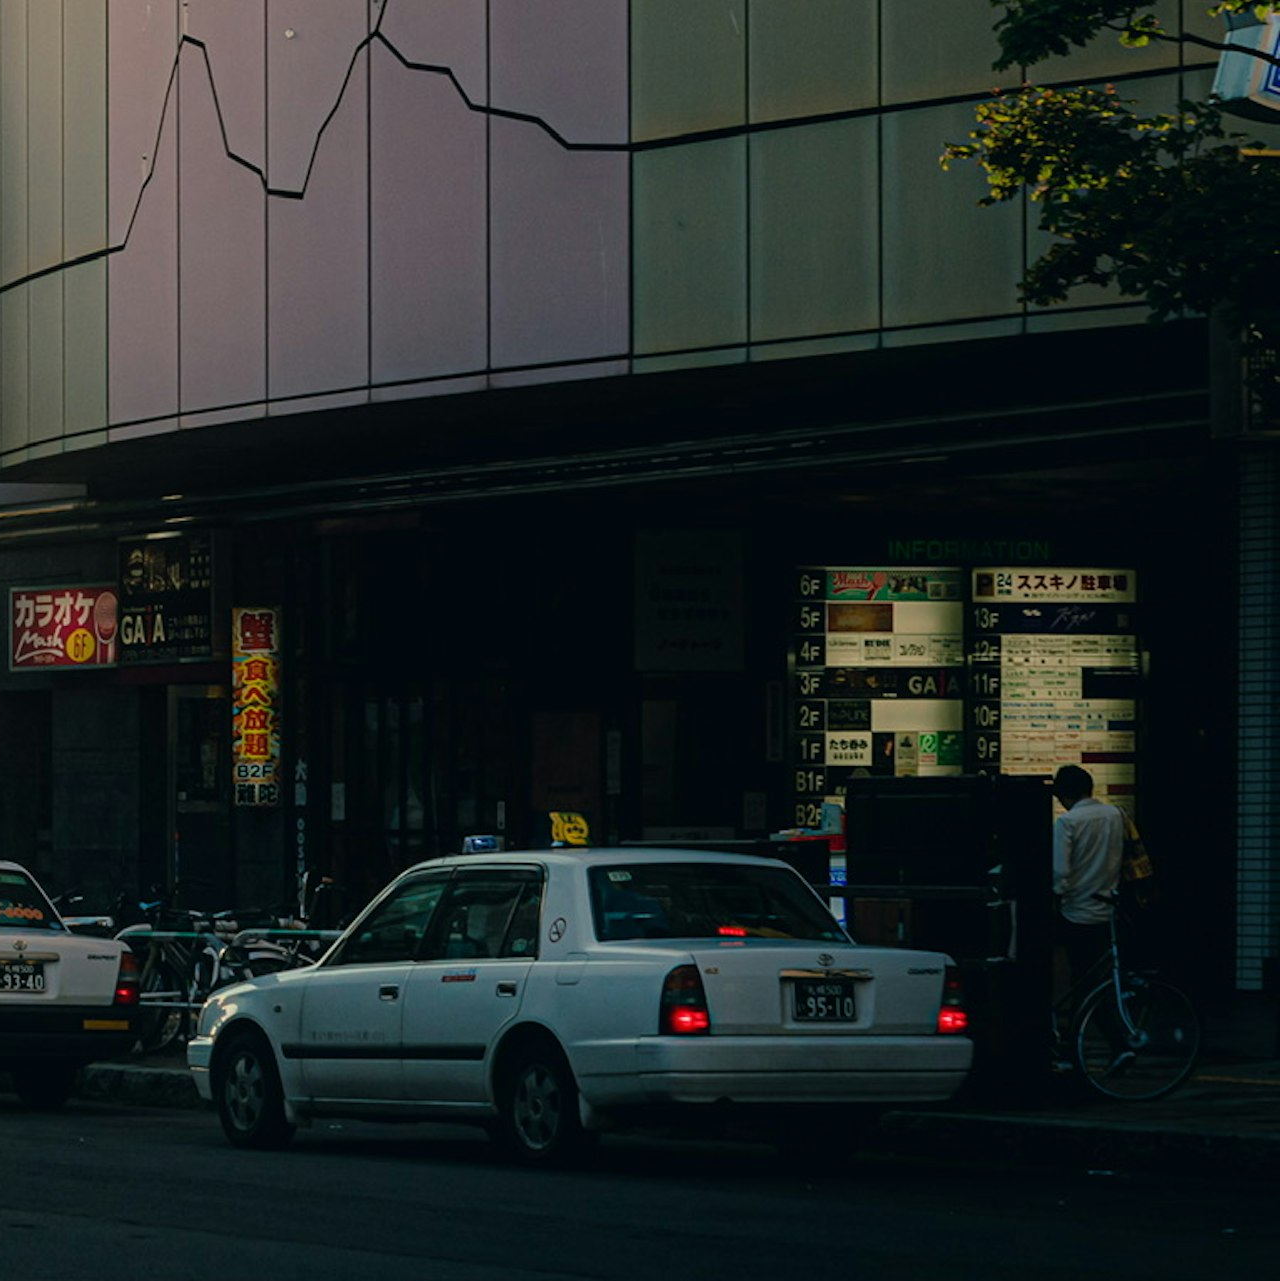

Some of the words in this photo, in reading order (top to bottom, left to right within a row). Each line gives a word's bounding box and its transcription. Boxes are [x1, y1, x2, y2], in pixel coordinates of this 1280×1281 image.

[887, 540, 1050, 562] INFORMATION
[799, 574, 821, 596] 6F
[996, 573, 1013, 587] 24
[14, 591, 95, 629] カラオケ
[799, 607, 821, 629] 5F
[974, 608, 1000, 629] 13F
[15, 623, 65, 658] Mash
[800, 642, 821, 662] 4F
[799, 672, 821, 696] 3F
[973, 673, 1000, 695] 11F
[243, 658, 271, 758] 食べ放題
[799, 705, 821, 728] 2F
[973, 704, 1000, 728] 10F
[799, 737, 821, 761] 1F
[976, 736, 999, 760] 9F
[237, 764, 273, 778] B2F
[795, 771, 825, 793] B1F
[3, 973, 44, 990] 93-40
[806, 996, 854, 1018] 95-10
